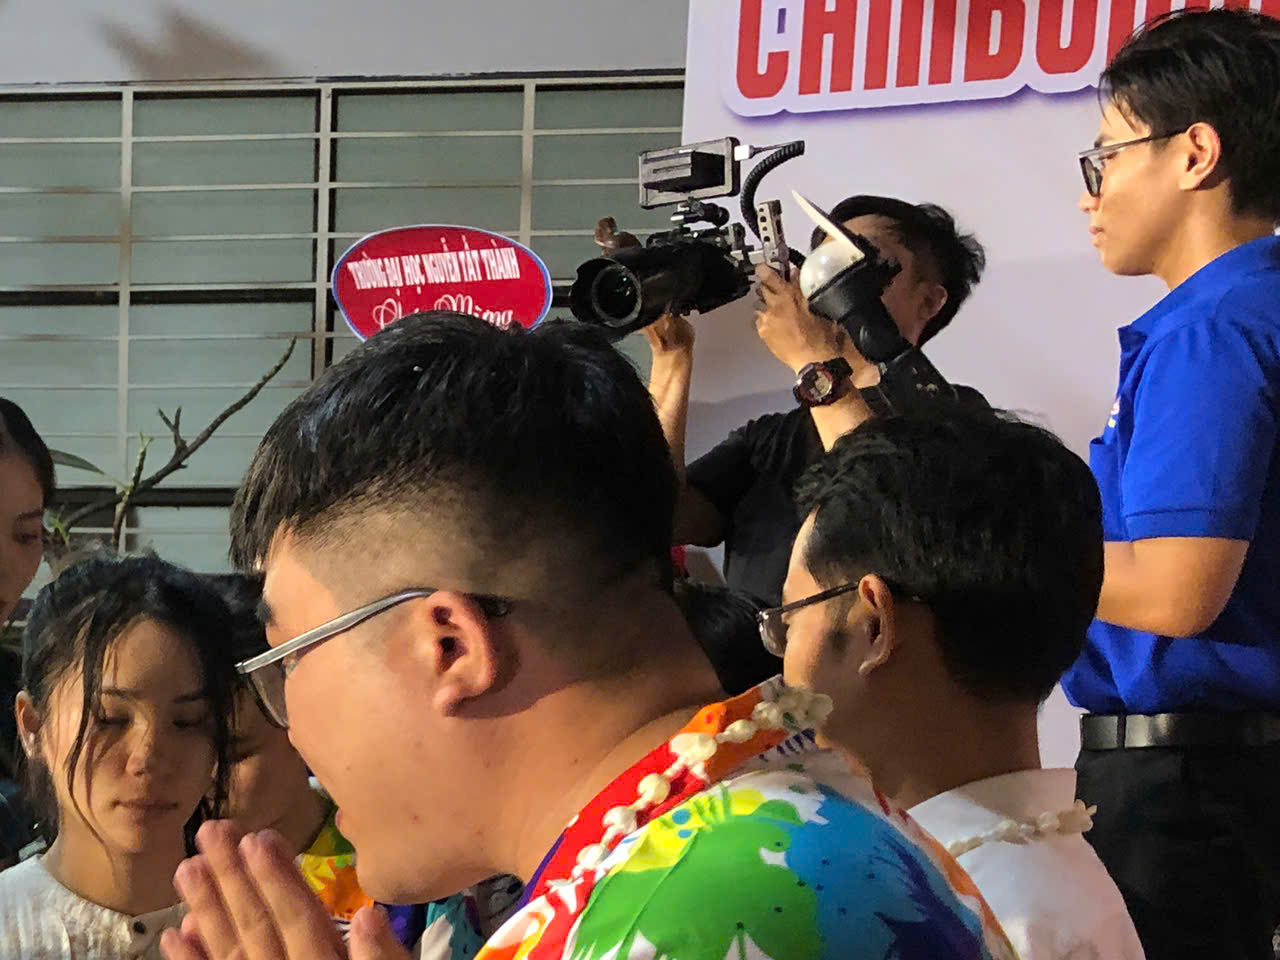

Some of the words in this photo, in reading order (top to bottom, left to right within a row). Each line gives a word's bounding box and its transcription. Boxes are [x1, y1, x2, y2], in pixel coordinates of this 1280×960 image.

[736, 0, 1280, 99] CAMBO
[401, 254, 425, 294] HỌC
[480, 238, 520, 281] THÀNH
